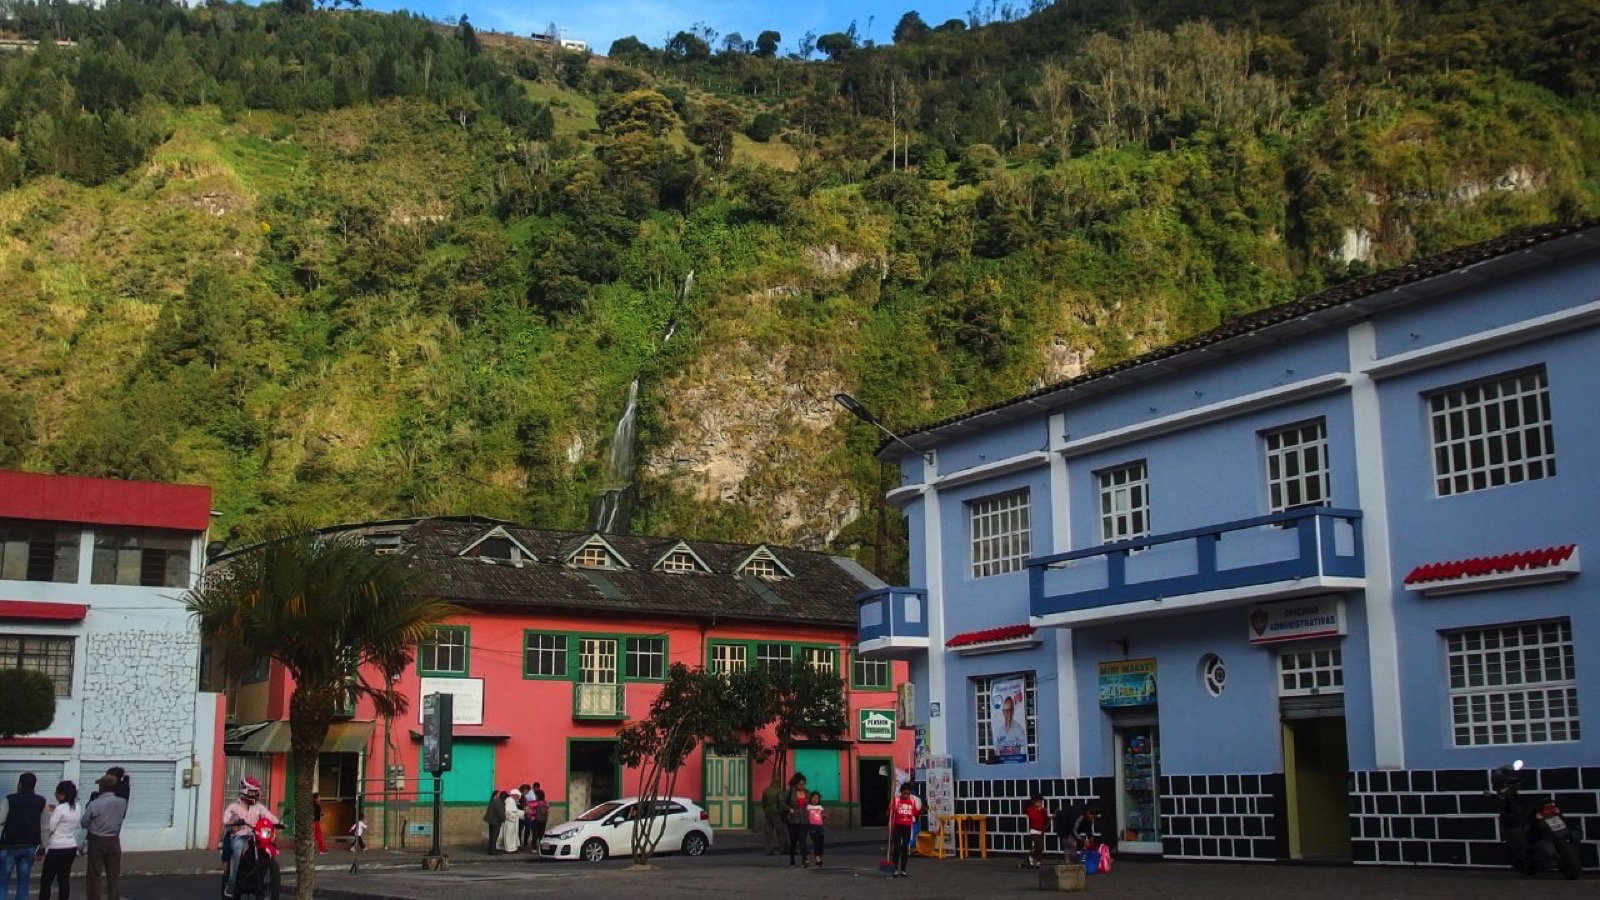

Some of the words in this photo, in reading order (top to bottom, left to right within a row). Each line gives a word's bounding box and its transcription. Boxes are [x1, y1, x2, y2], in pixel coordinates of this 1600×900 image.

[1284, 606, 1319, 617] OFICINAS
[1269, 616, 1336, 631] ADMINISTRATIVAS
[1121, 662, 1154, 674] MARKET
